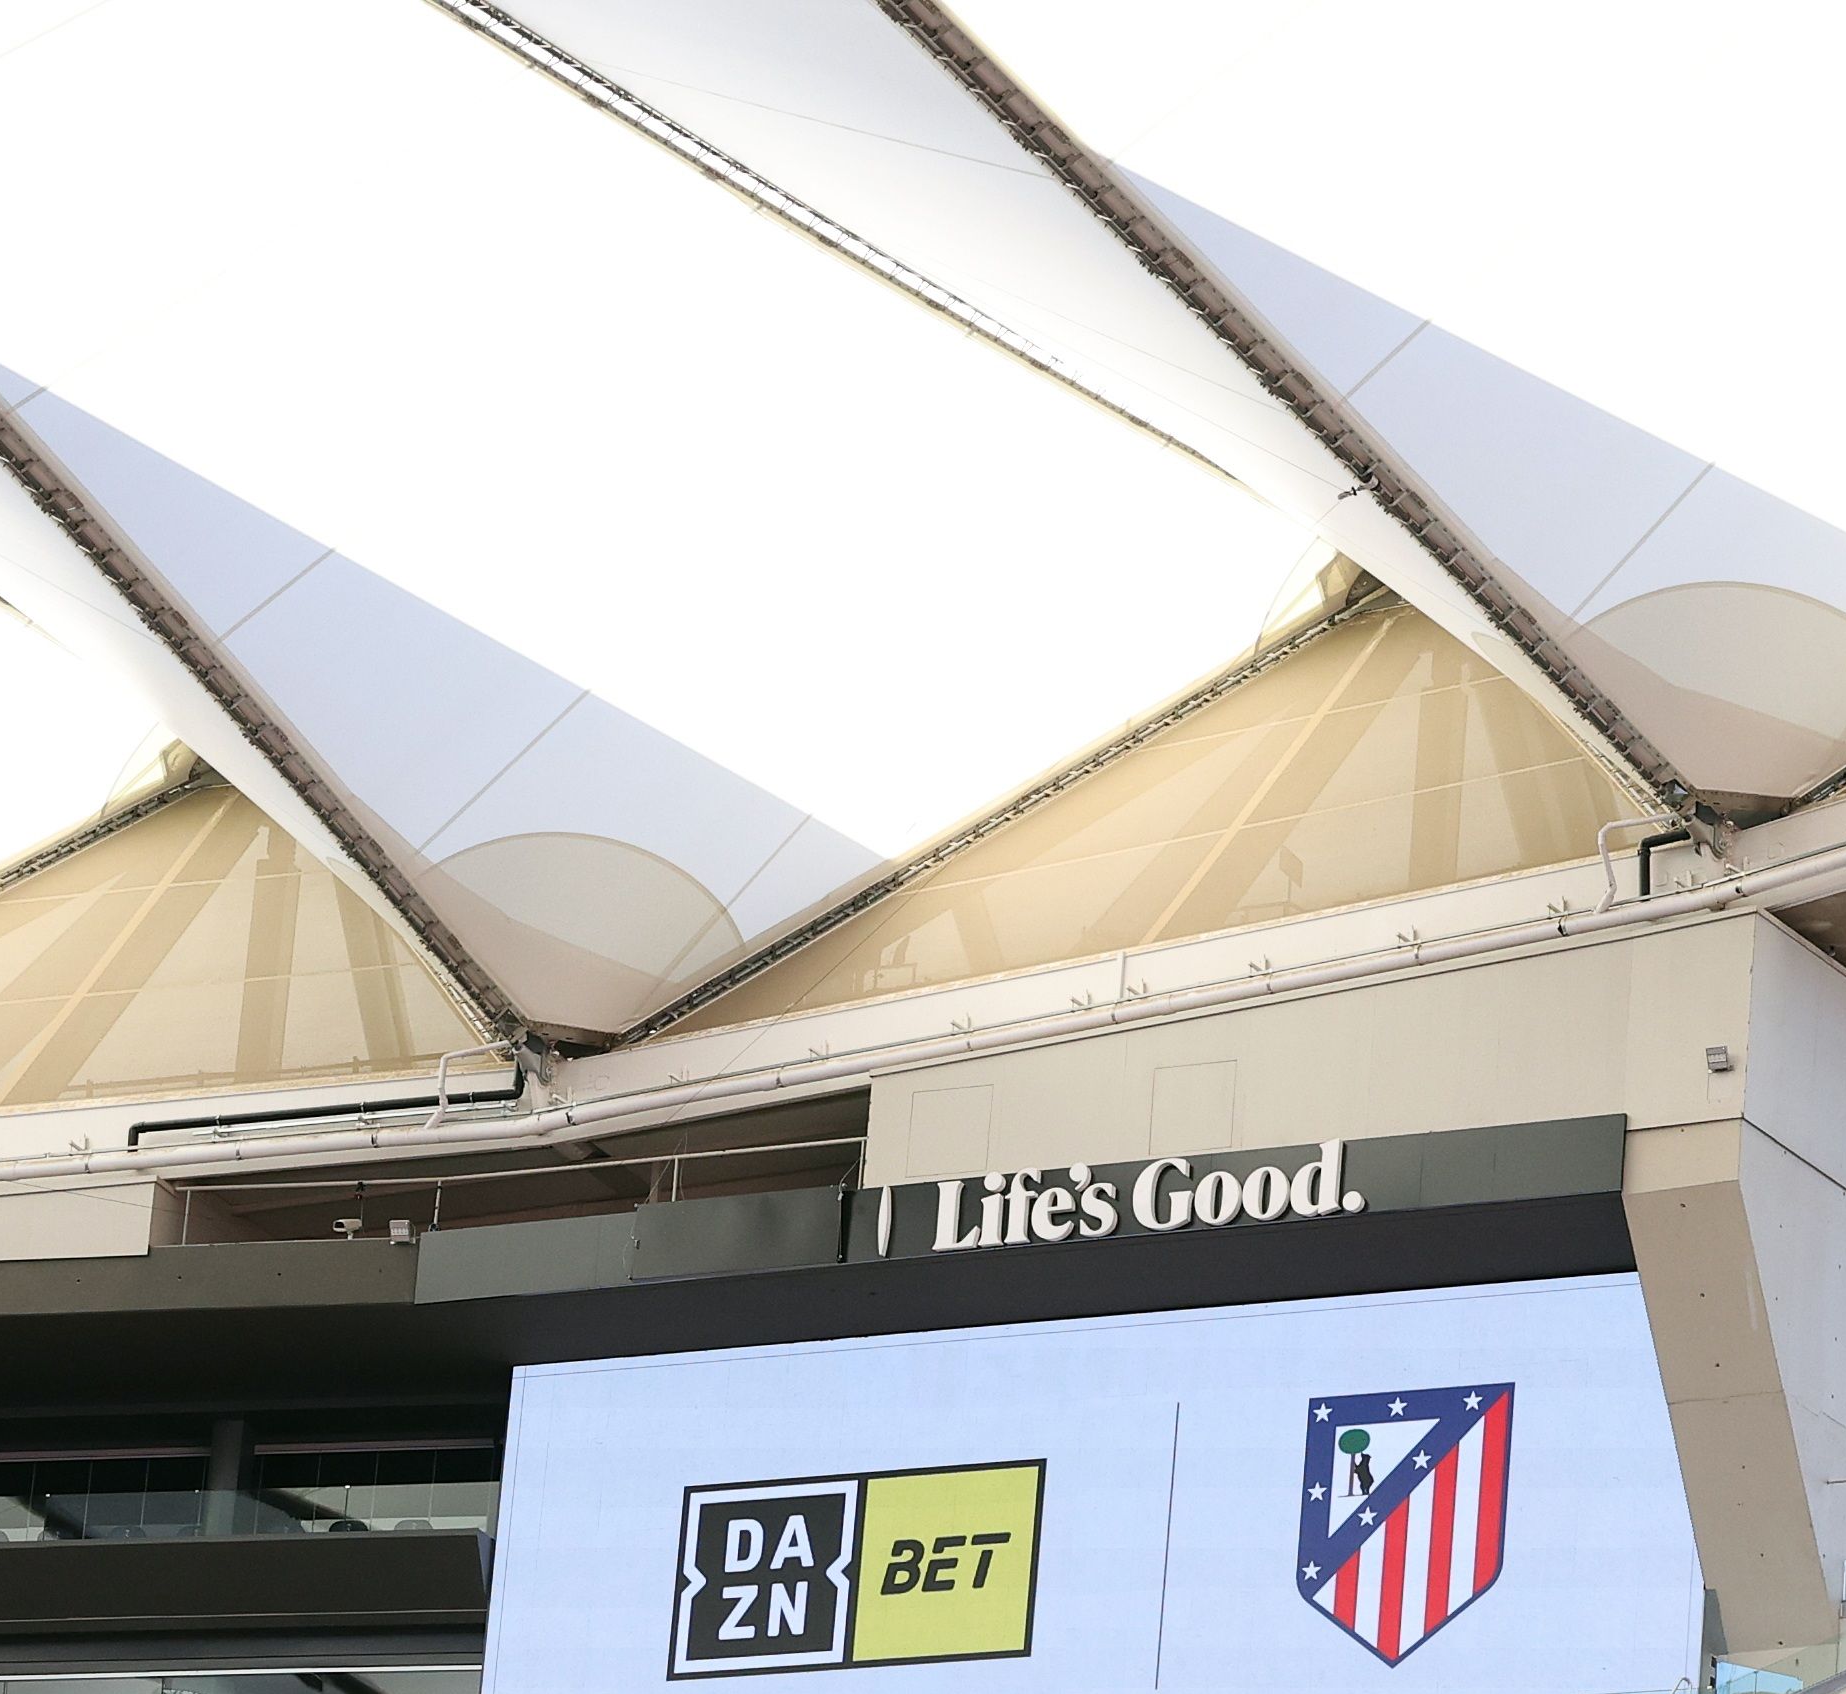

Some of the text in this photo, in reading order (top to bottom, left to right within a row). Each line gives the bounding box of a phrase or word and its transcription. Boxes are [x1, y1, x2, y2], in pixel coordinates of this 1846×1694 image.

[932, 1139, 1366, 1253] Life's Good.
[880, 1532, 1011, 1595] BET
